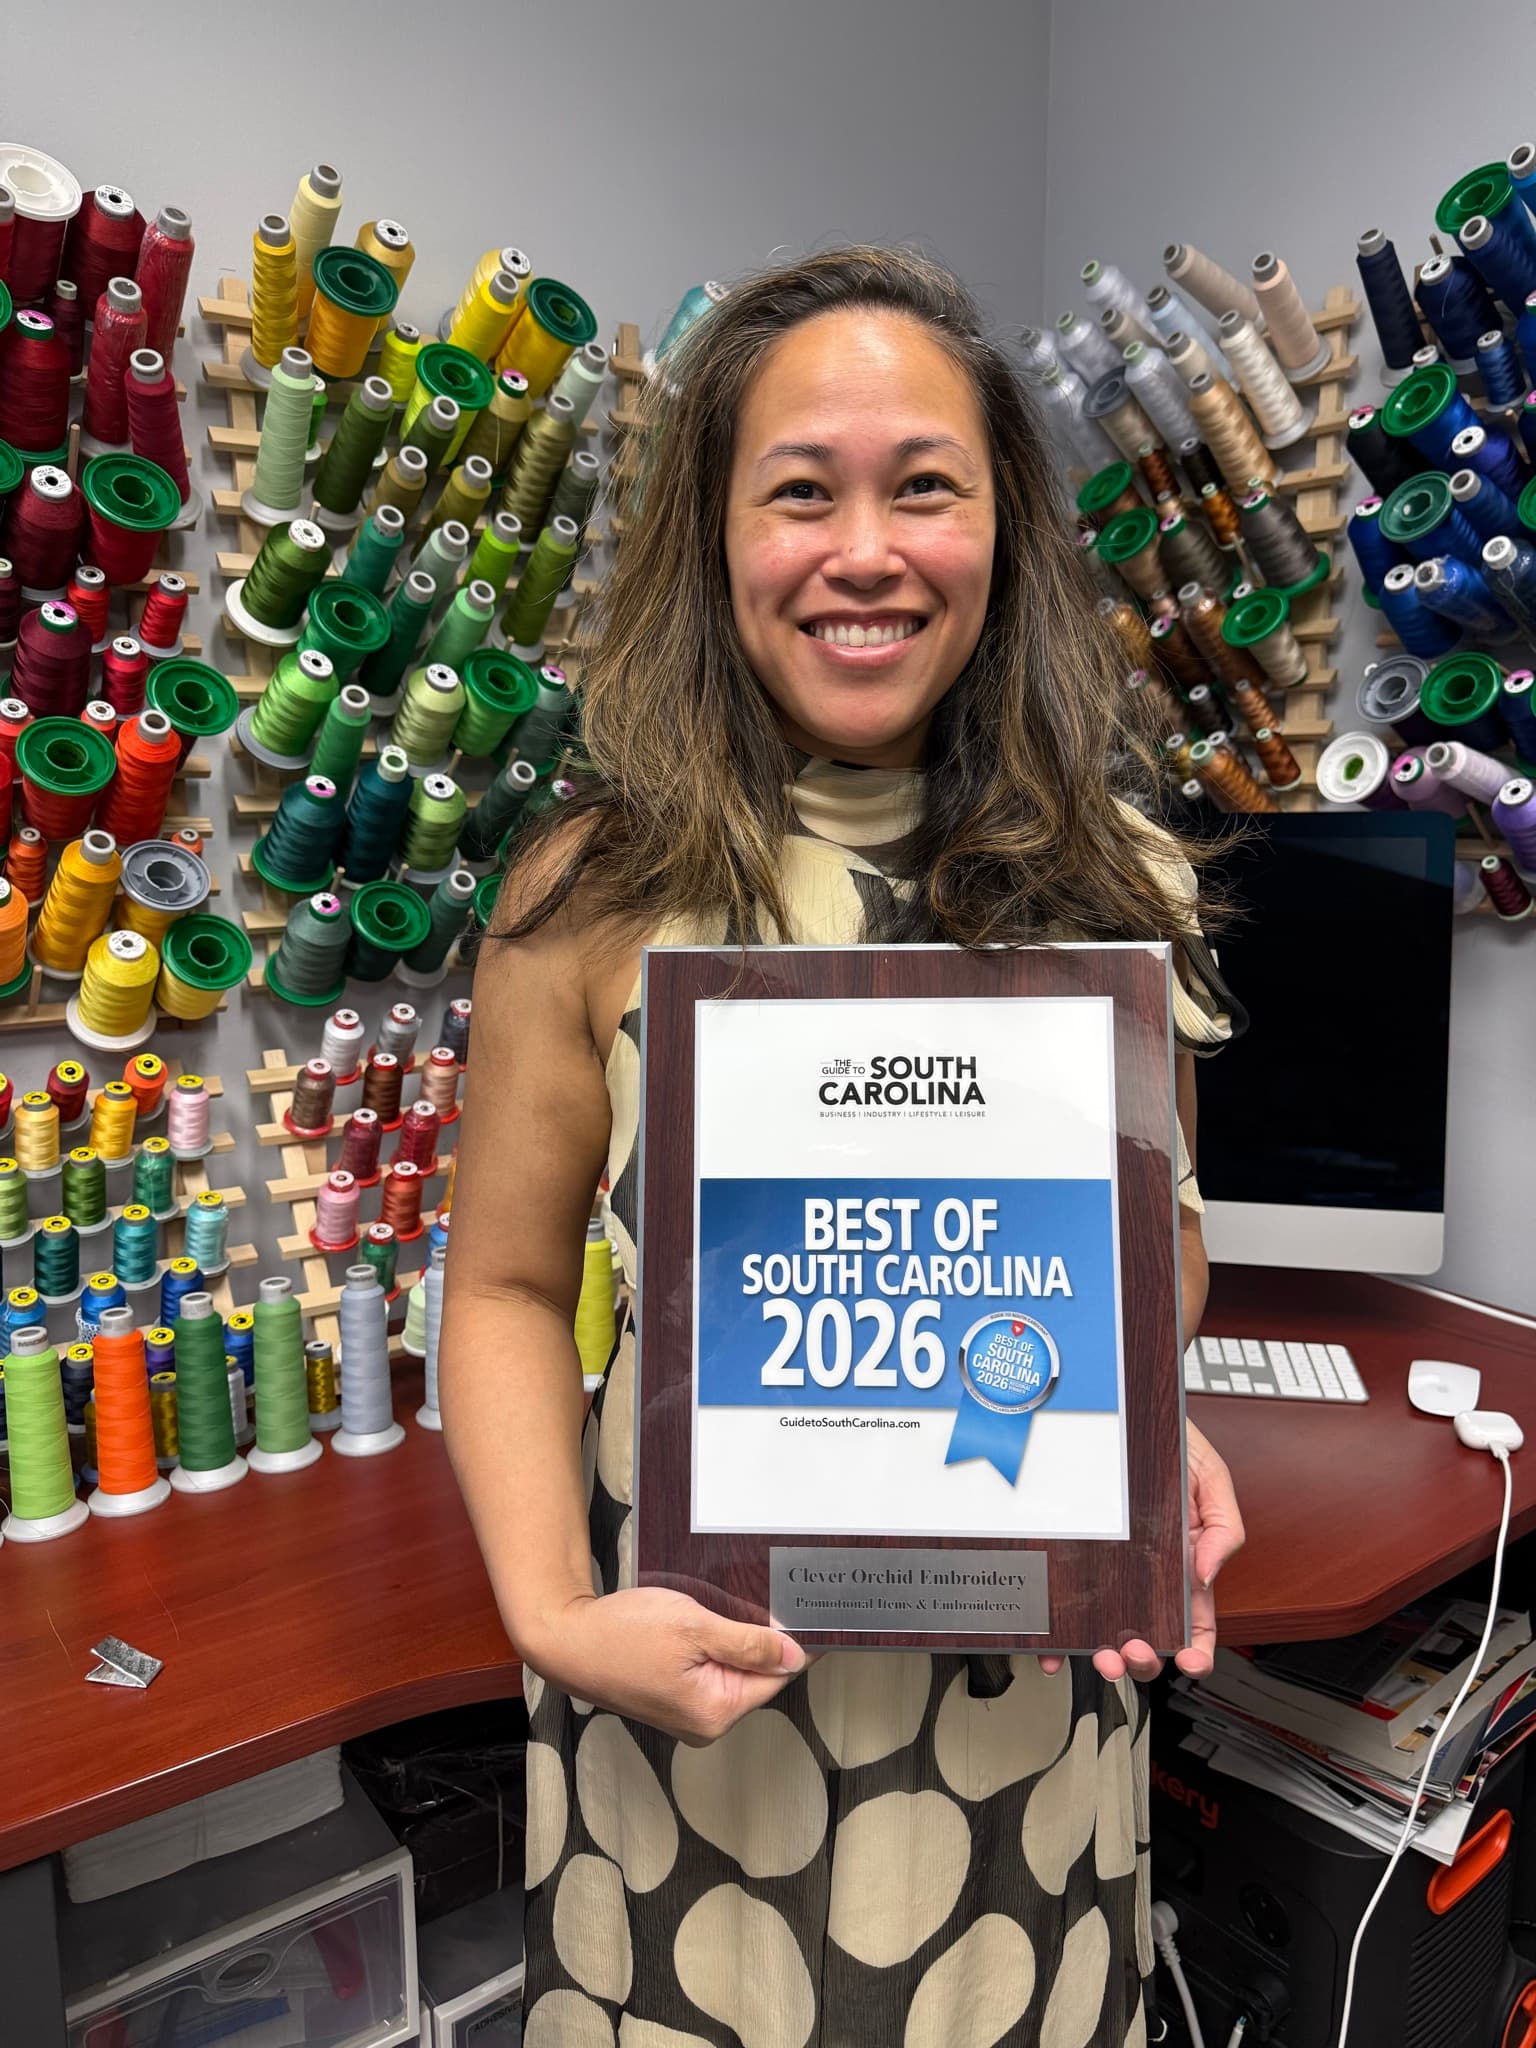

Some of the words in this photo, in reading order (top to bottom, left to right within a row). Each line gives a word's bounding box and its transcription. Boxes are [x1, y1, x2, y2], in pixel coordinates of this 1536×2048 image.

[821, 1066, 850, 1075] GUIDE
[852, 1066, 866, 1075] TO
[833, 1059, 852, 1067] THE
[870, 1055, 977, 1080] SOUTH
[818, 1081, 986, 1106] CAROLINA
[804, 1197, 920, 1252] BEST
[933, 1197, 998, 1252] OF
[742, 1253, 863, 1296] SOUTH
[875, 1255, 1073, 1297] CAROLINA
[760, 1297, 946, 1389] 2026
[987, 1342, 1034, 1368] SOUTH
[994, 1333, 1019, 1349] BEST
[1020, 1341, 1036, 1353] OF
[972, 1353, 1041, 1387] CAROLINA
[976, 1370, 1009, 1390] 2026
[779, 1416, 921, 1429] GuidetoSouthCarolina.com
[788, 1567, 847, 1584] Clever
[851, 1568, 913, 1585] Orchid
[919, 1569, 1026, 1590] Embroidery
[795, 1597, 874, 1610] Promotional
[876, 1598, 913, 1611] Items
[916, 1599, 928, 1610] &
[932, 1599, 1021, 1612] Embroiderers
